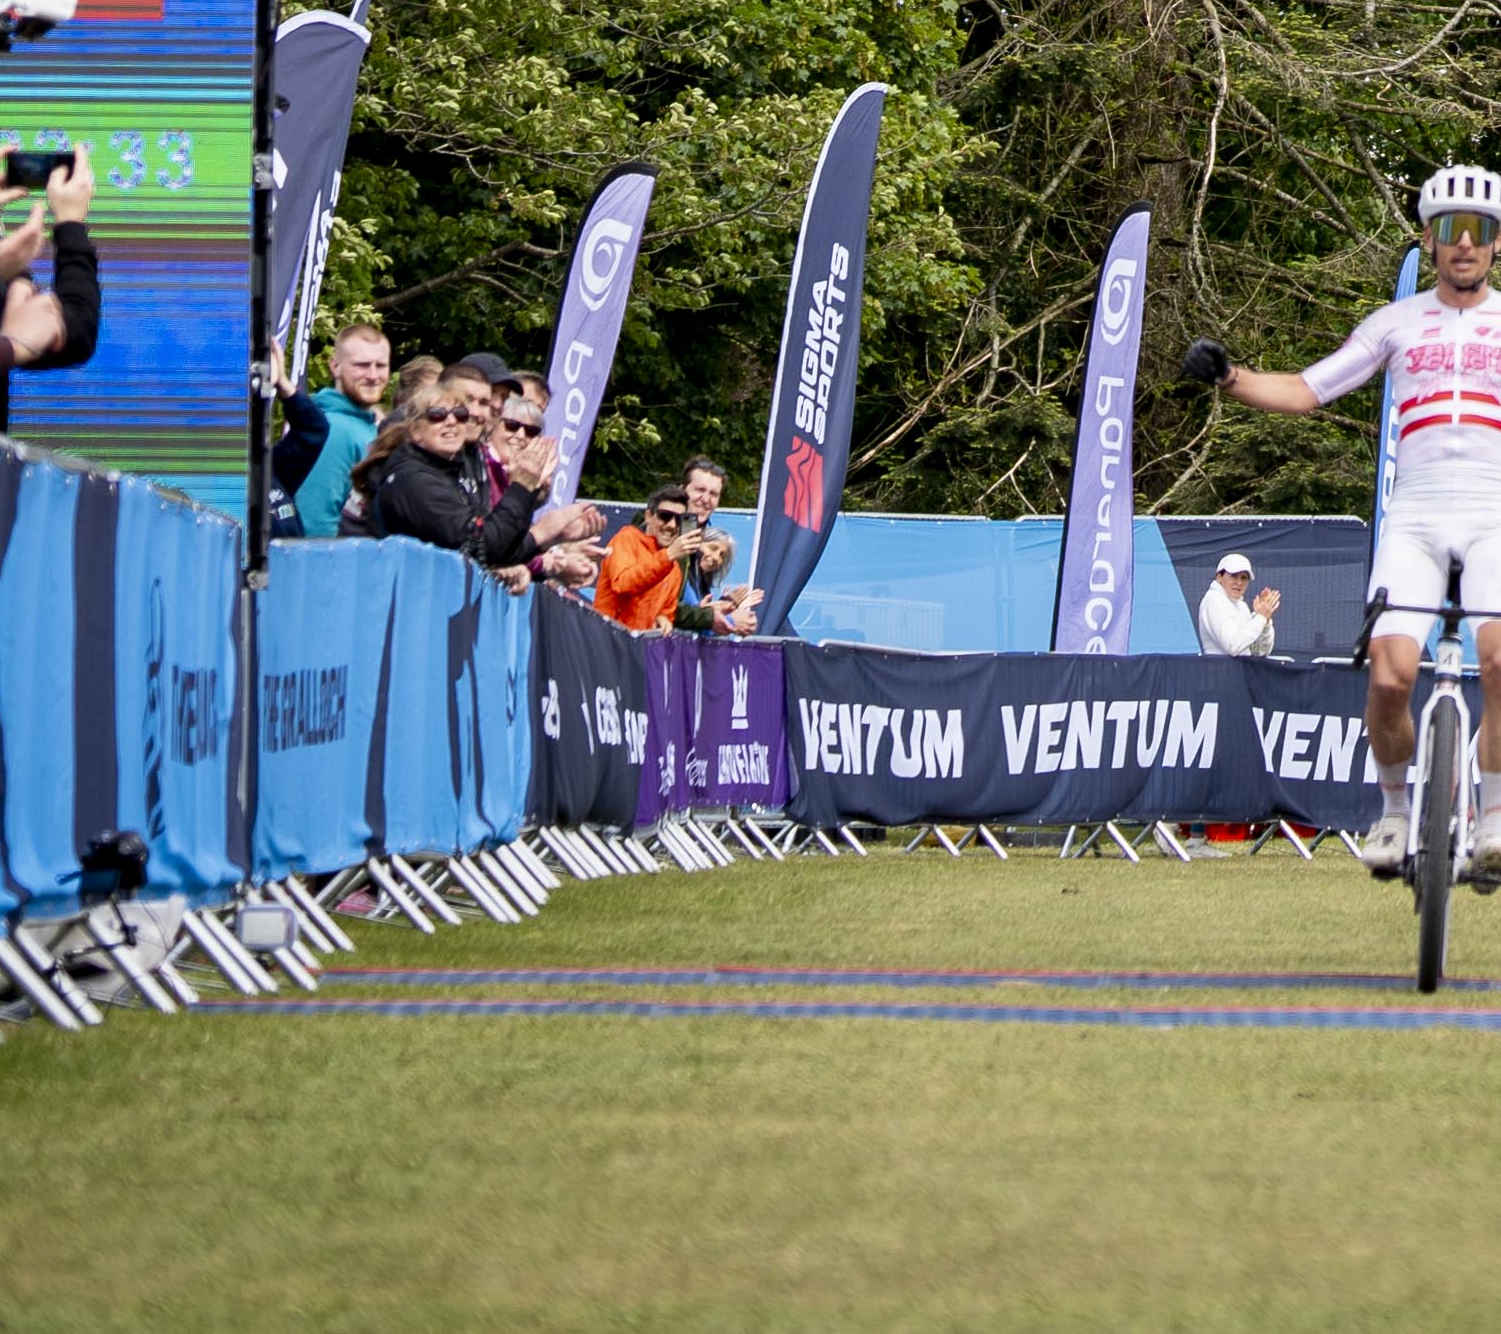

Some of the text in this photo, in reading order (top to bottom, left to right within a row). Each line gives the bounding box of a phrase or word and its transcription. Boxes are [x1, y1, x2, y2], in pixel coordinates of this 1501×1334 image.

[794, 279, 829, 434] SIGMA
[812, 241, 851, 445] SPORTS
[798, 697, 965, 780] VENTUM
[1000, 698, 1220, 776] VENTUM
